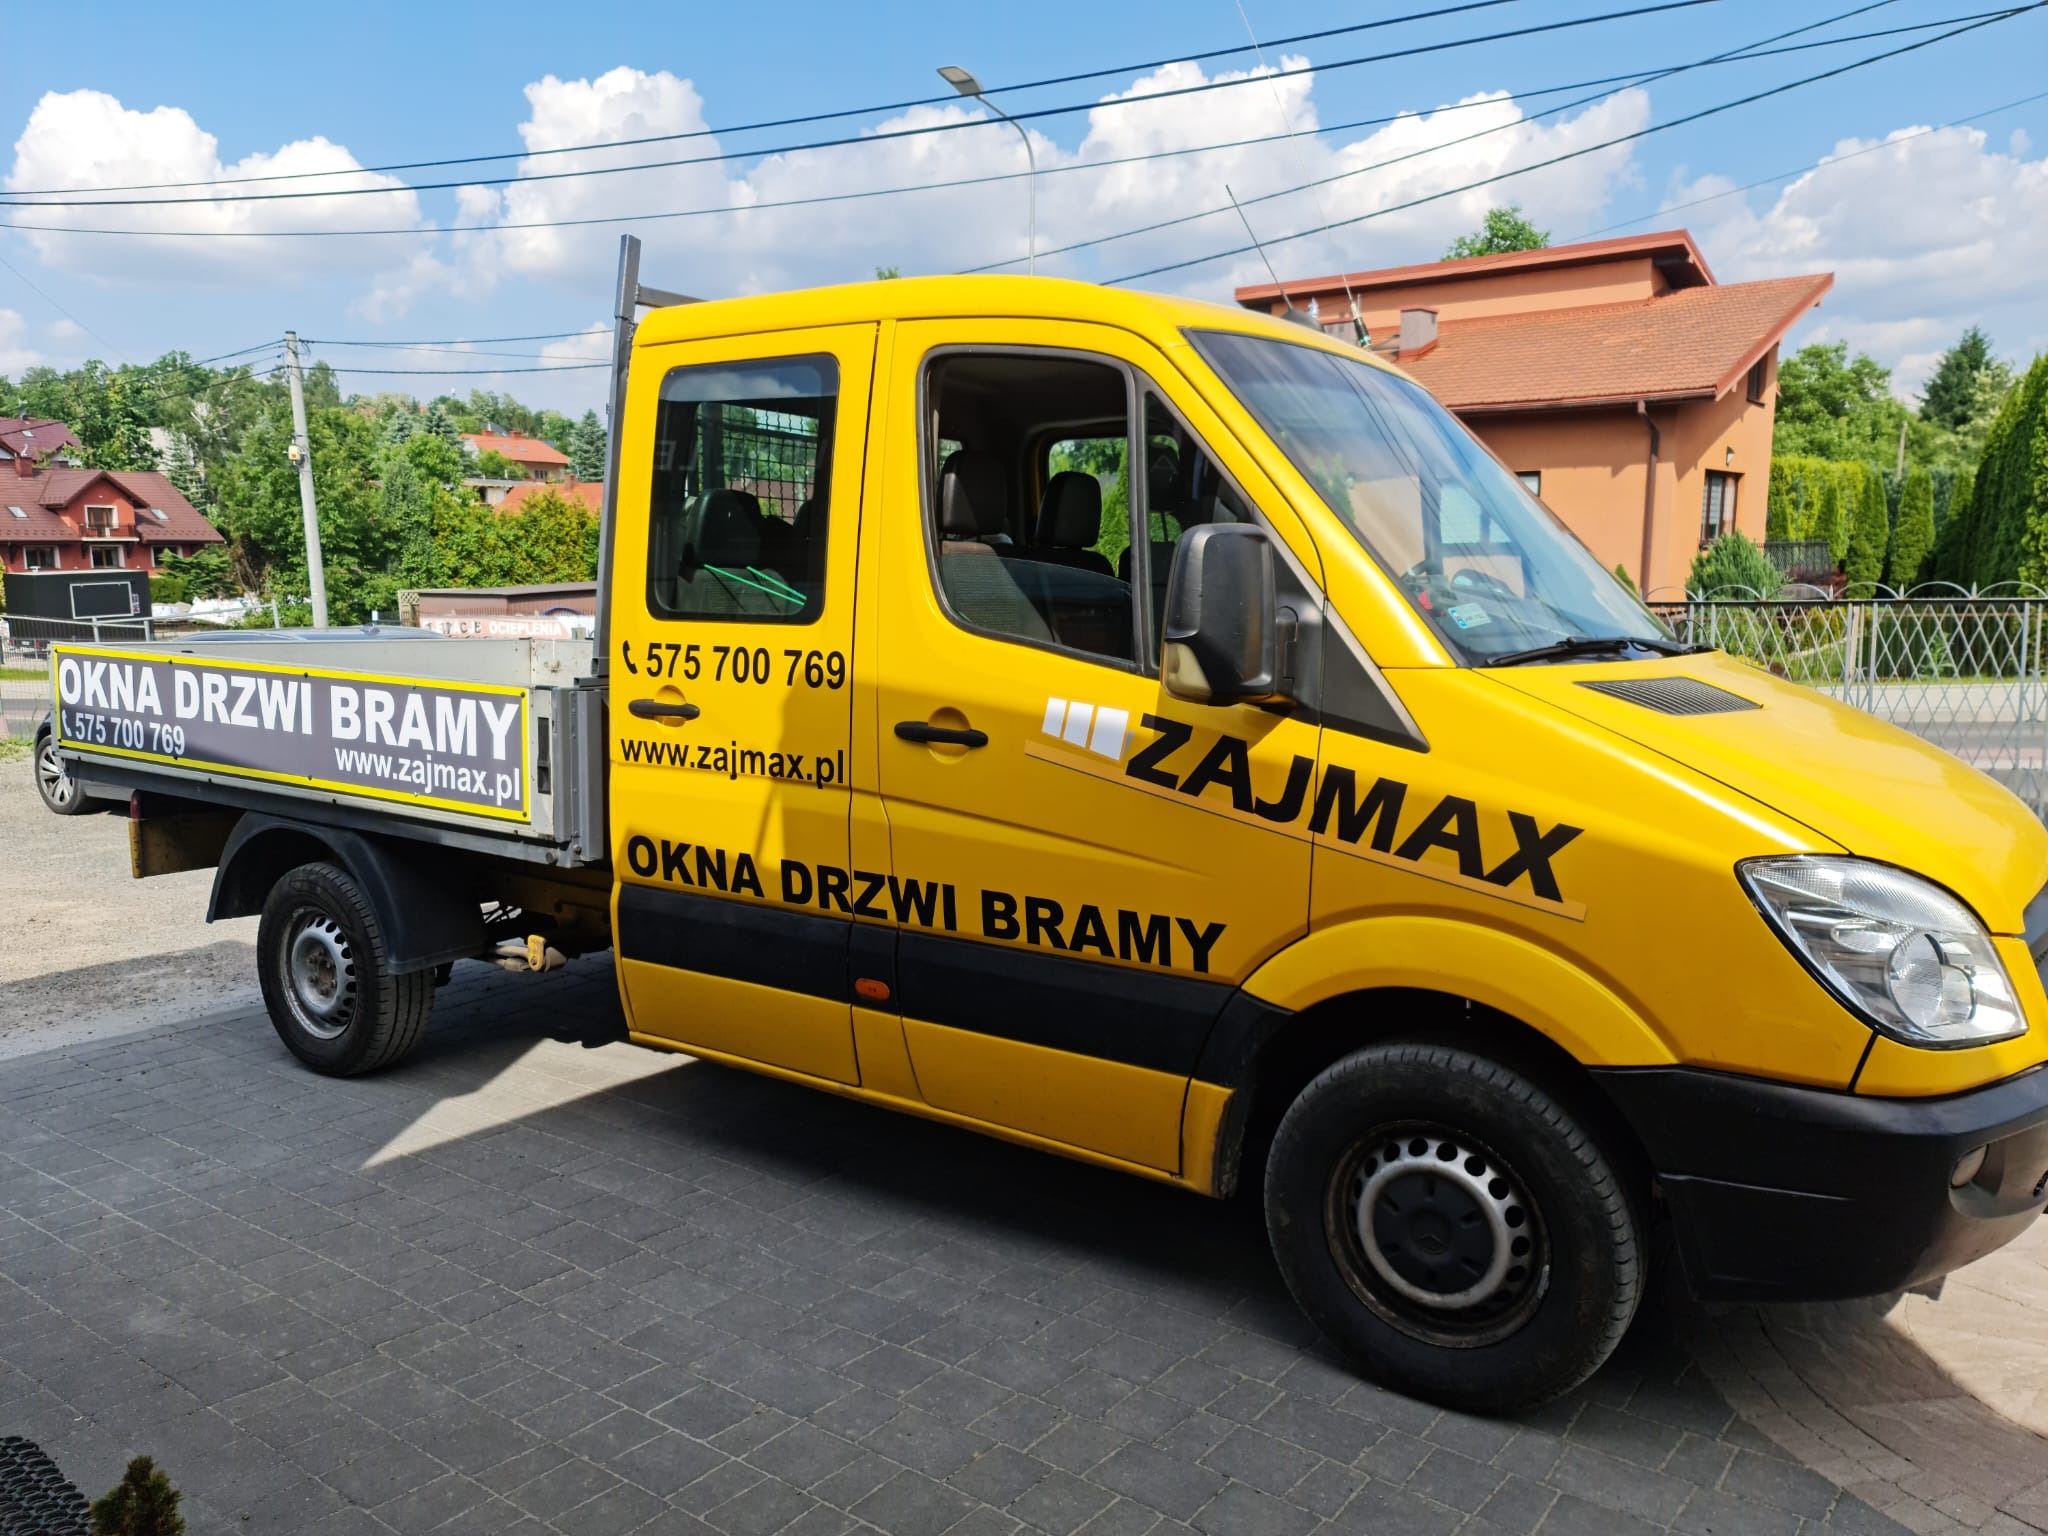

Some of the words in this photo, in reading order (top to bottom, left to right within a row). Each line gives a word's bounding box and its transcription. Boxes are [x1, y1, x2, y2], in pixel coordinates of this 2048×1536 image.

[488, 620, 562, 636] OCIEPLENIA
[647, 642, 700, 680] 575
[713, 646, 770, 684] 700
[784, 649, 846, 690] 769
[57, 657, 163, 716] OKNA
[173, 668, 313, 736] DRZWI
[329, 684, 522, 761] BRAMY
[75, 712, 107, 743] 575
[109, 716, 145, 749] 700
[148, 721, 186, 755] 769
[333, 746, 522, 807] www.zajmax.pl
[620, 738, 844, 790] www.zajmax.pl
[1124, 712, 1585, 904] ZAJMAX
[627, 834, 766, 899] OKNA
[780, 858, 958, 932] DRZWI
[980, 888, 1228, 975] BRAMY
